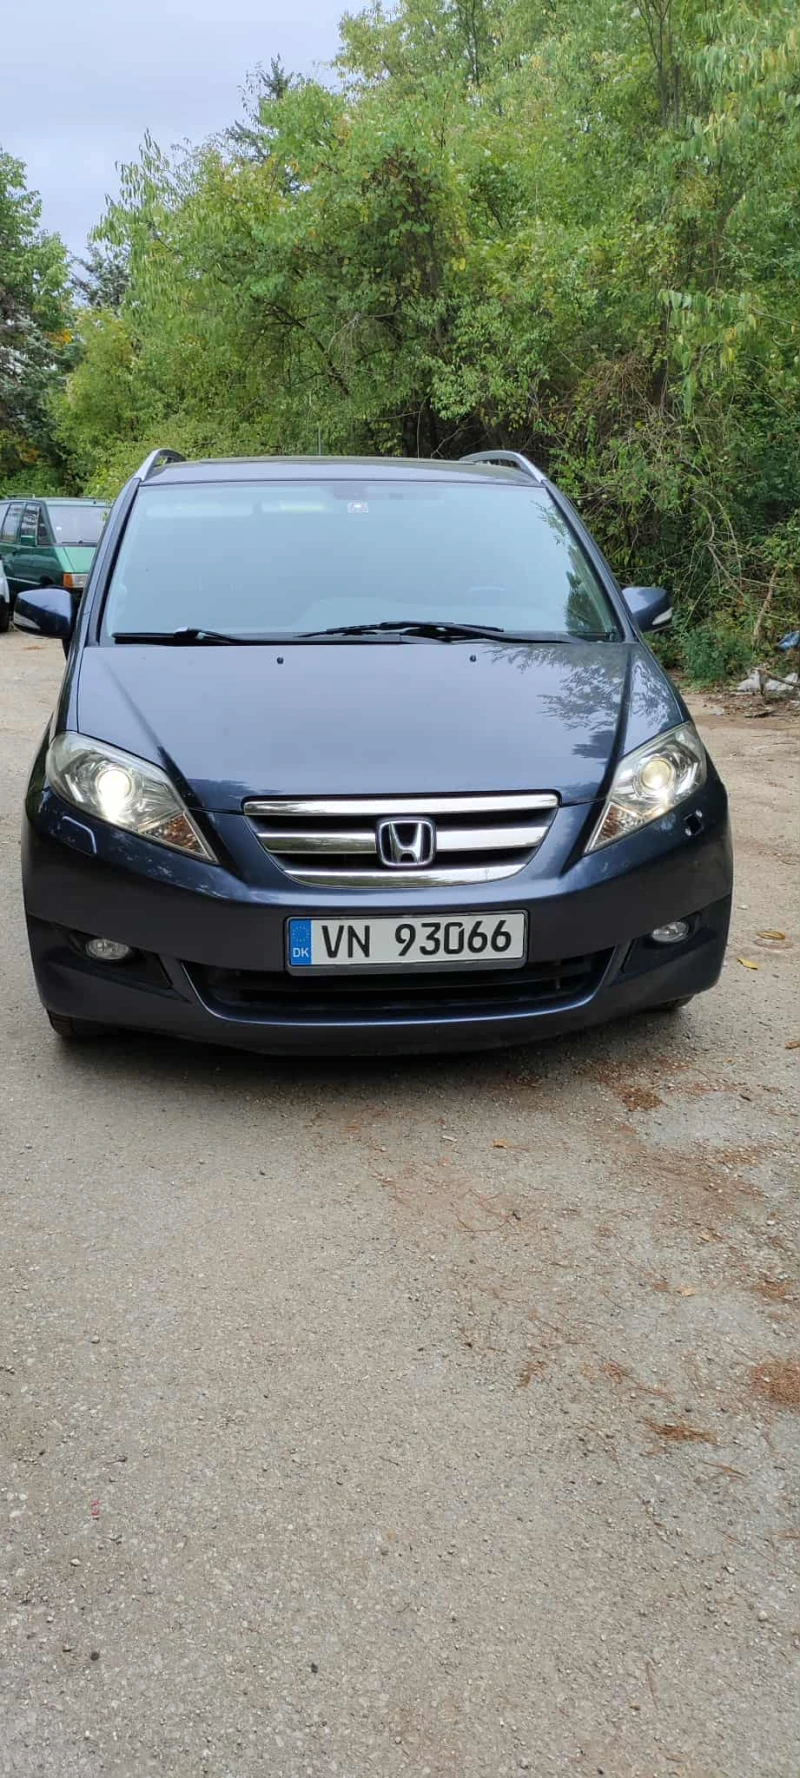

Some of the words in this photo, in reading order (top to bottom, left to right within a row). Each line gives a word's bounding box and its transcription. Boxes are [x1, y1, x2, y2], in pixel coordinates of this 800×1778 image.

[321, 925, 370, 958] VN
[395, 920, 512, 956] 93066
[292, 947, 309, 958] DK
